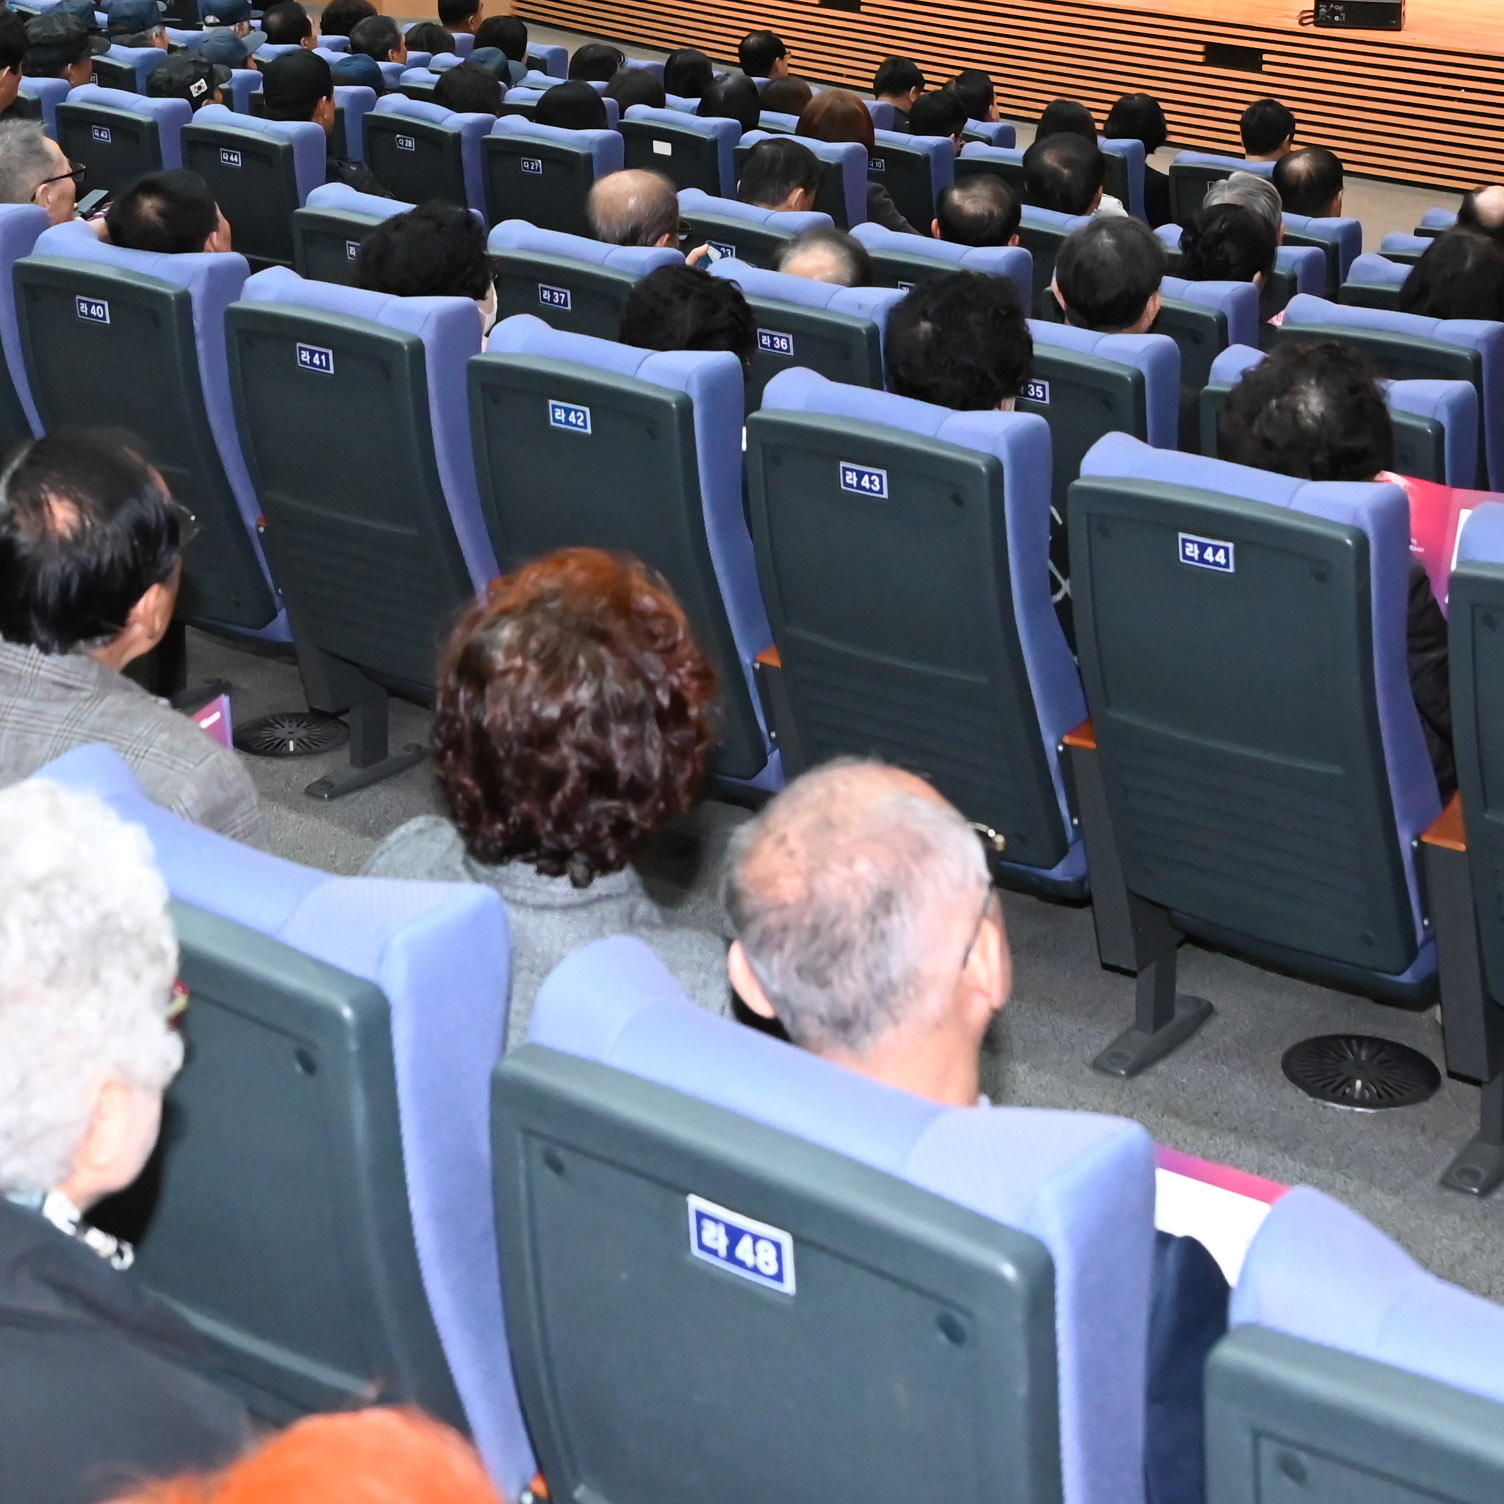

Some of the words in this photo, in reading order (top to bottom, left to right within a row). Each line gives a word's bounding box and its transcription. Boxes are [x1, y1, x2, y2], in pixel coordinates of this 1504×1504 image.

[542, 289, 551, 302] 라
[552, 291, 566, 304] 37
[79, 302, 88, 316] 라
[90, 304, 104, 317] 40
[761, 334, 771, 348] 라
[773, 336, 788, 350] 36
[300, 350, 310, 365] 라
[313, 352, 326, 367] 41
[1027, 383, 1043, 398] 35
[554, 407, 566, 423] 라
[568, 410, 585, 426] 42
[845, 470, 858, 487] 라
[860, 474, 880, 491] 43
[1185, 542, 1200, 561] 라
[1203, 546, 1226, 565] 44
[700, 1217, 729, 1259] 라
[734, 1233, 779, 1277] 48
